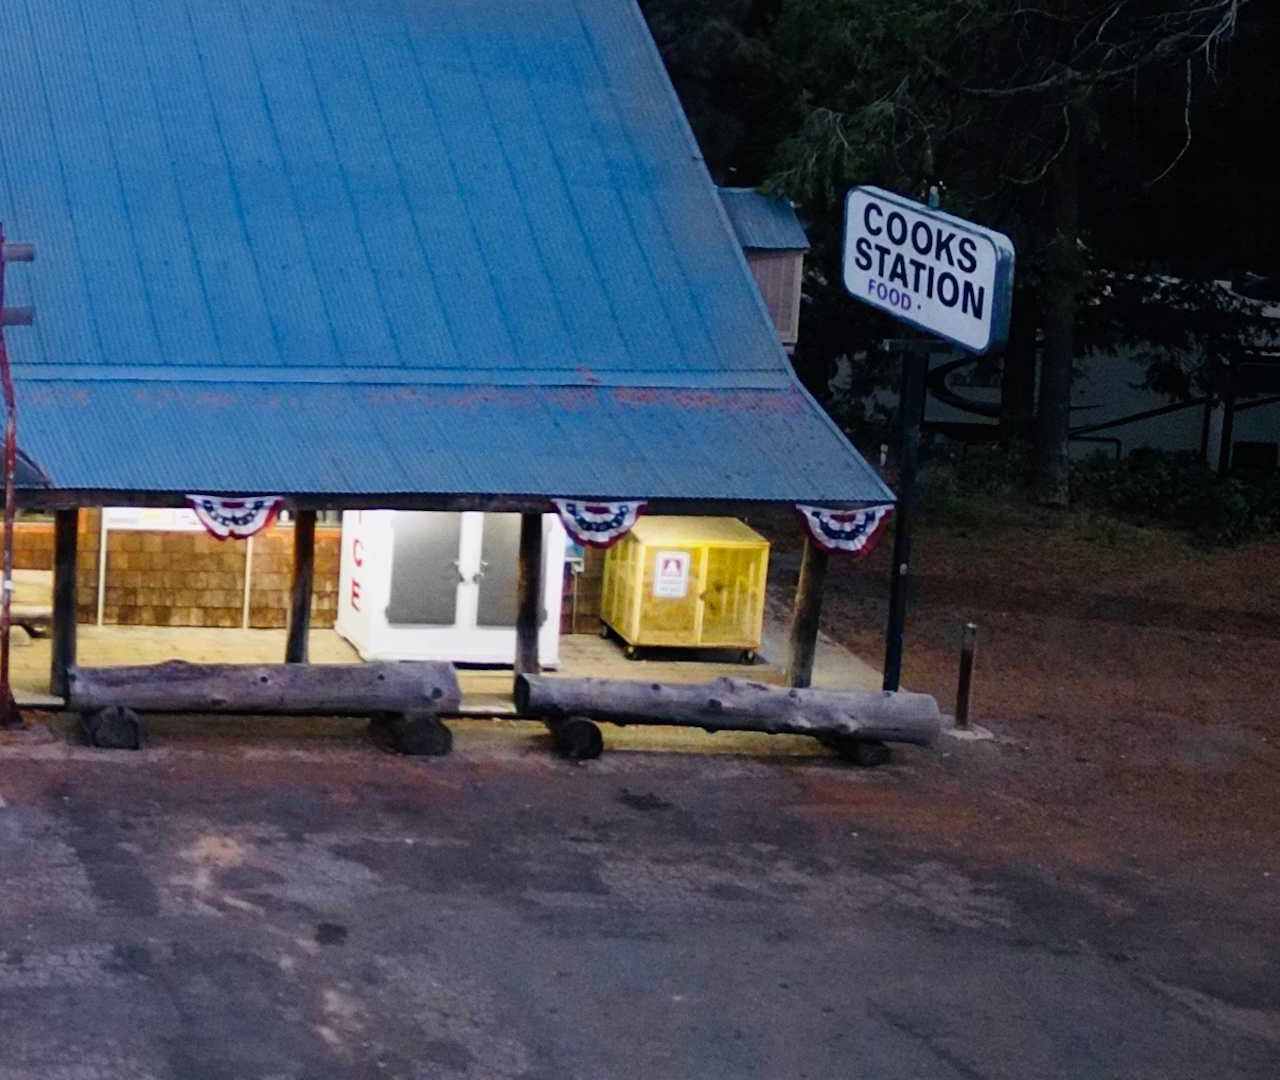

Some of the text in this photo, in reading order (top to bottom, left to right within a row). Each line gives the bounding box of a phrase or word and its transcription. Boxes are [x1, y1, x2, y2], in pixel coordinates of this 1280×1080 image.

[864, 202, 977, 273] COOKS
[855, 237, 985, 320] STATION
[868, 278, 912, 311] FOOD
